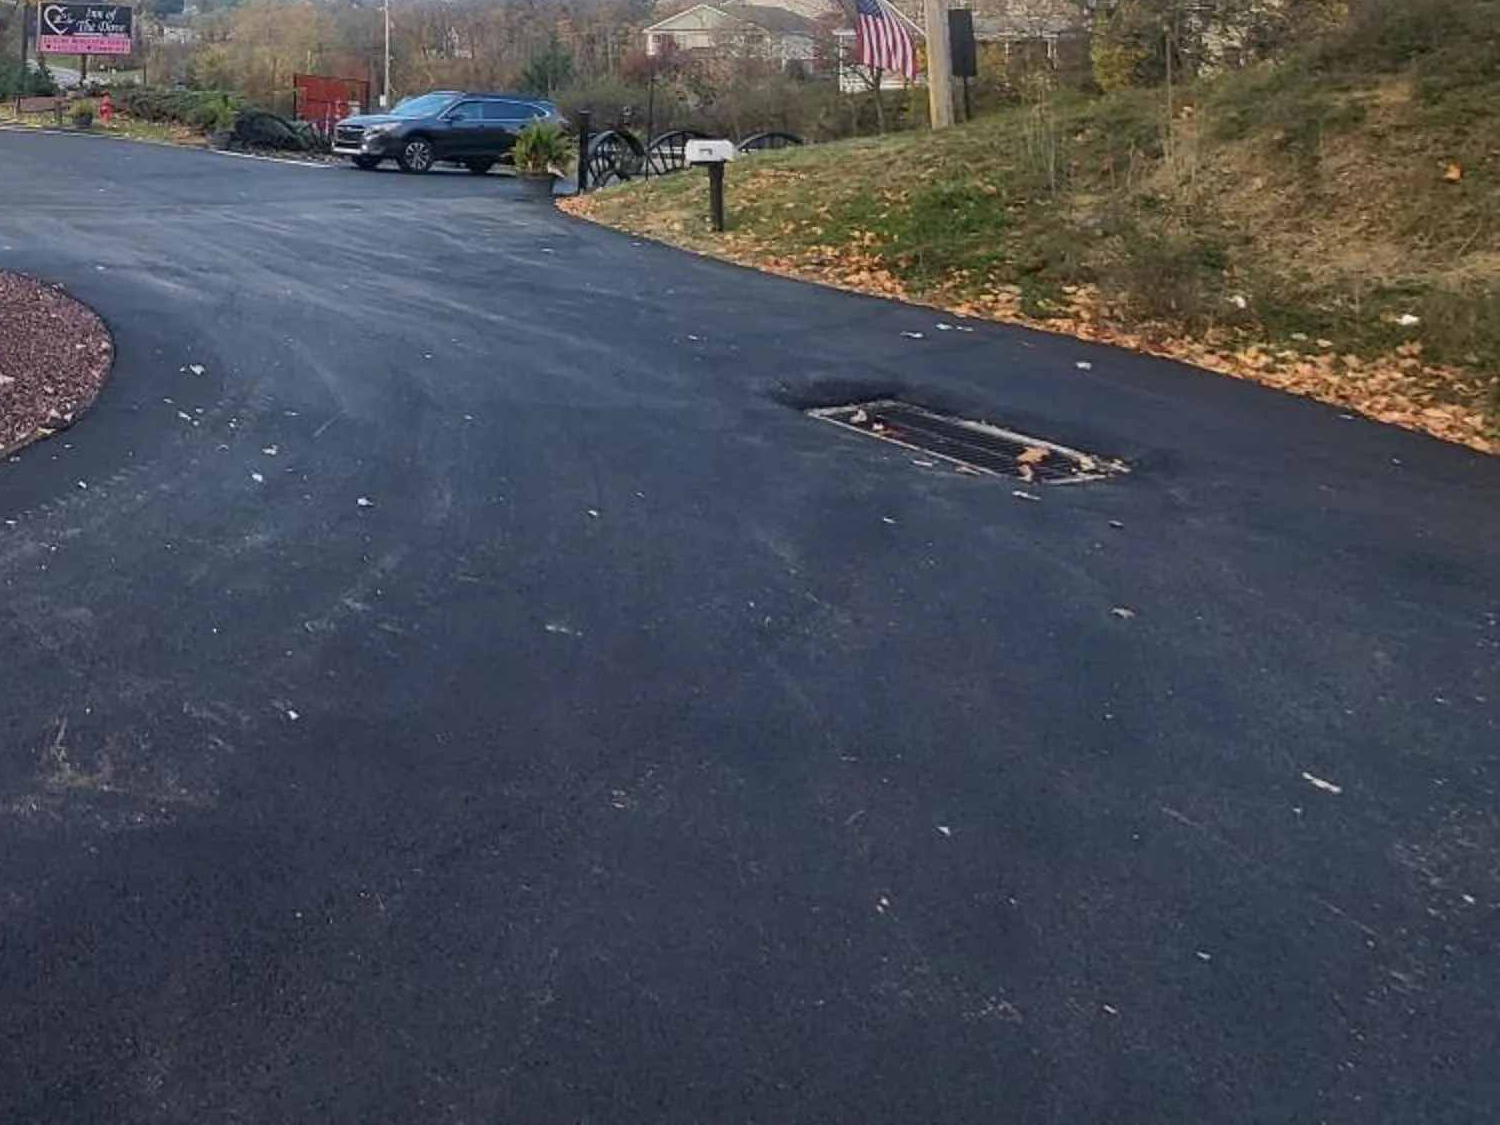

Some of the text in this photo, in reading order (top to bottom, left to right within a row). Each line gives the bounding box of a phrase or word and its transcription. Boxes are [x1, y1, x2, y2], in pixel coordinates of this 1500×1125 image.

[86, 7, 118, 20] Inn of
[76, 19, 95, 32] The
